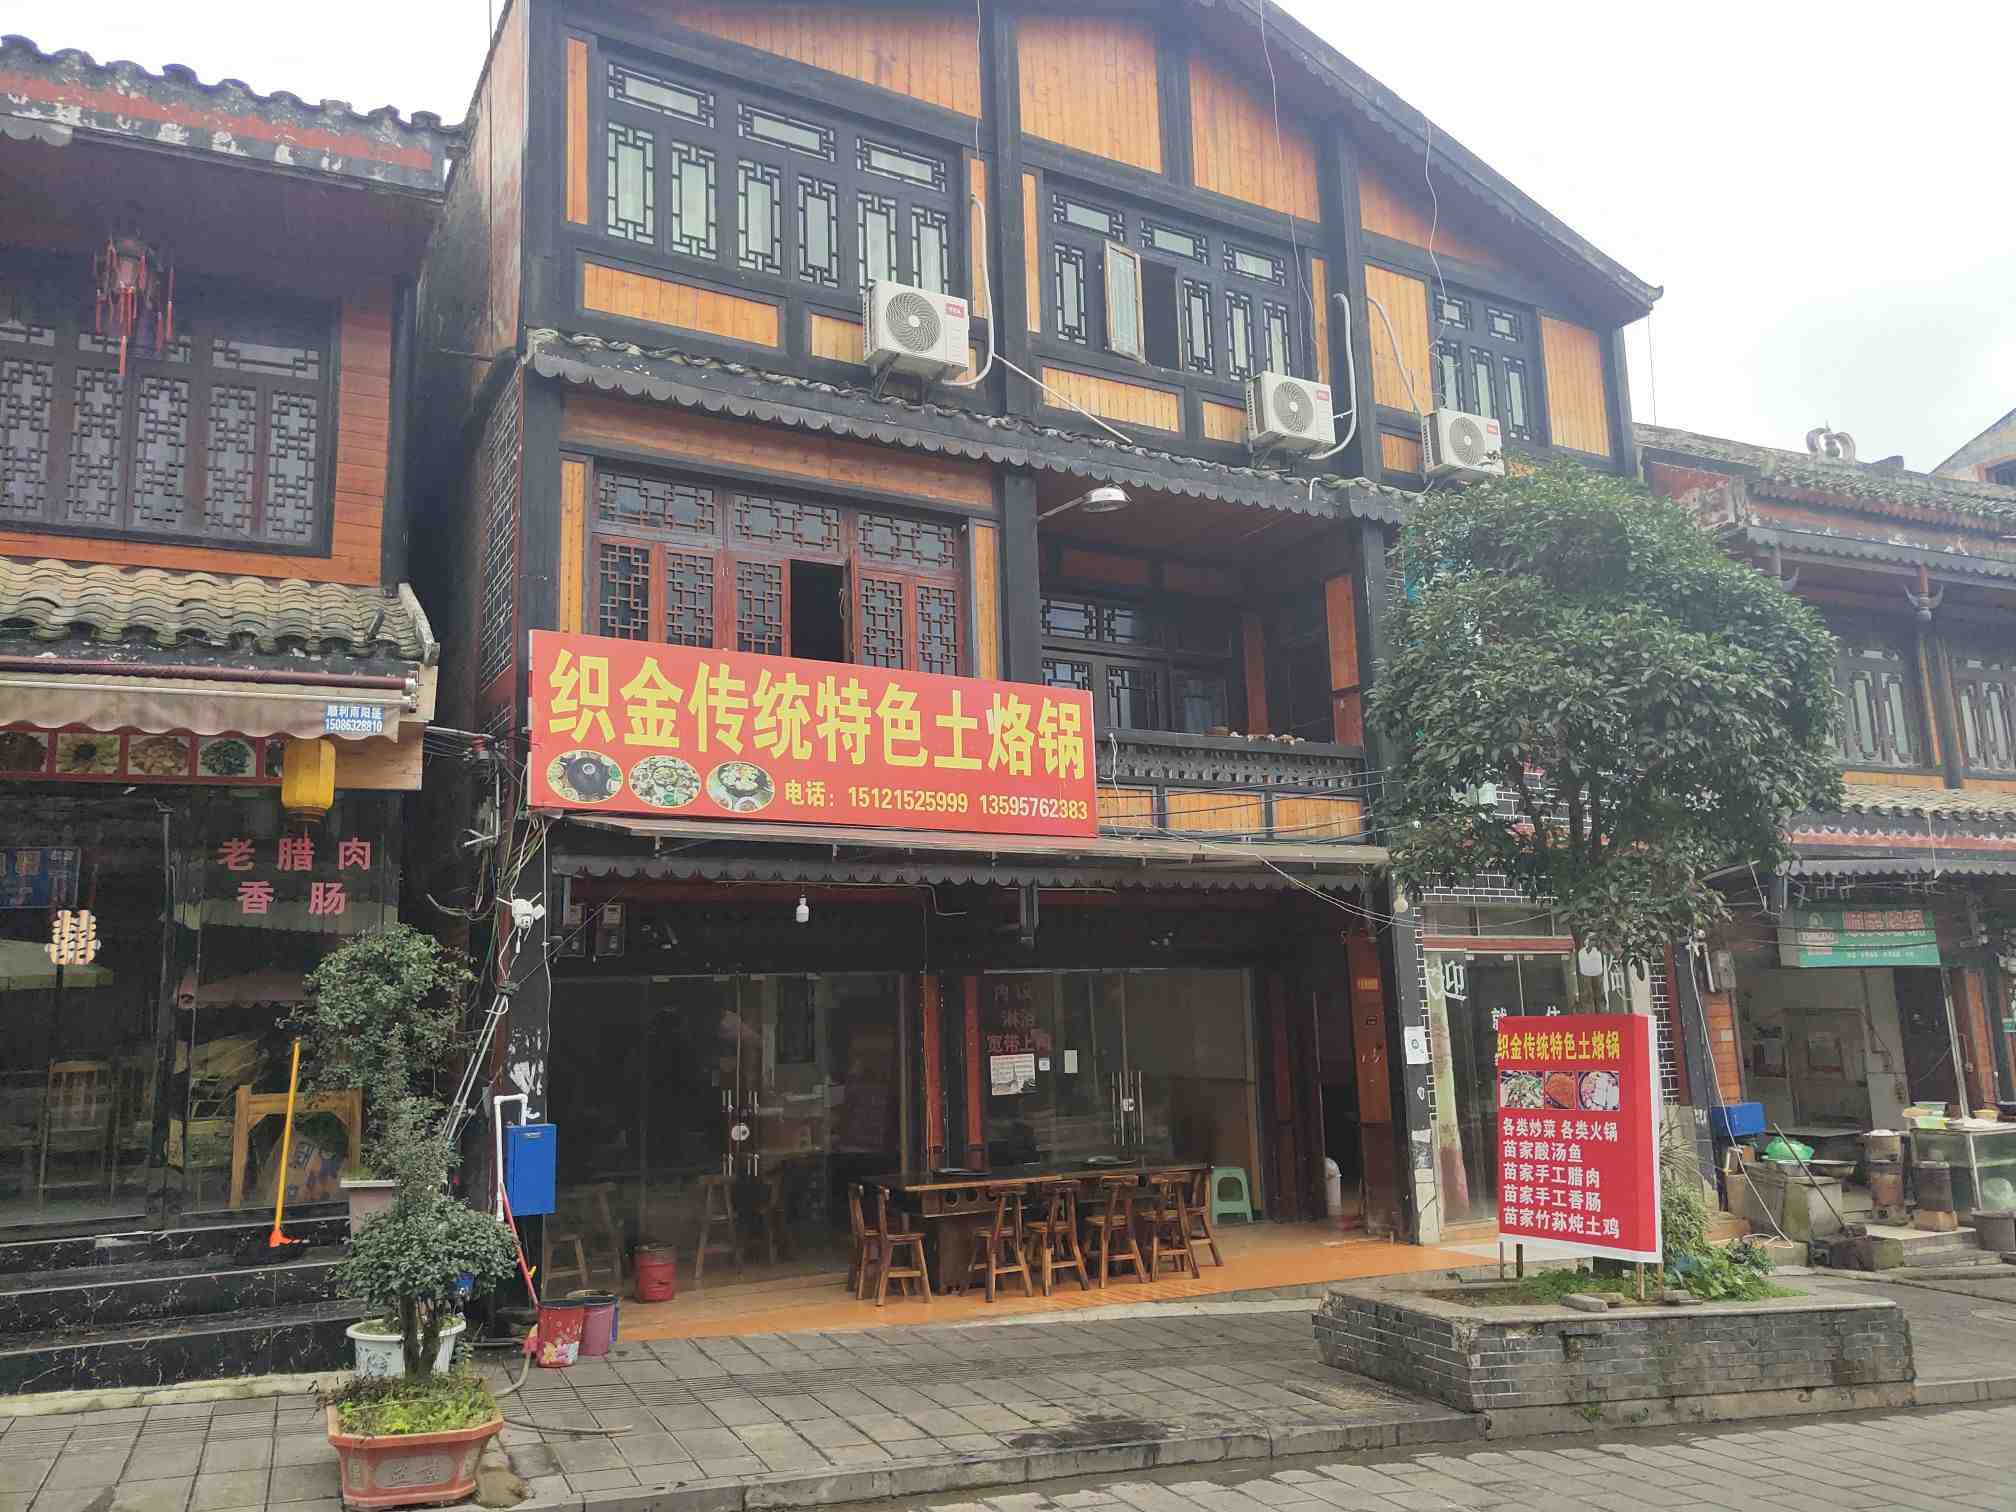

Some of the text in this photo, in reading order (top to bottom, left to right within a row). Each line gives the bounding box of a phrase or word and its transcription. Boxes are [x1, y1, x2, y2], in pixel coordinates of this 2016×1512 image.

[547, 649, 1085, 780] 织金传统特色土烙锅
[848, 786, 969, 813] 15121525999
[979, 793, 1088, 820] 13595762383
[217, 834, 371, 871] 老腊肉
[238, 880, 347, 915] 香肠
[1497, 1030, 1620, 1060] 织金传统特色土烙锅
[1503, 1117, 1618, 1143] 各类炒菜 各类火锅
[1503, 1139, 1583, 1163] 苗家酸汤鱼
[1503, 1162, 1600, 1189] 苗家手工腊肉
[1503, 1184, 1601, 1212] 苗家手工香肠
[1503, 1206, 1620, 1239] 苗家竹荪炖土鸡
